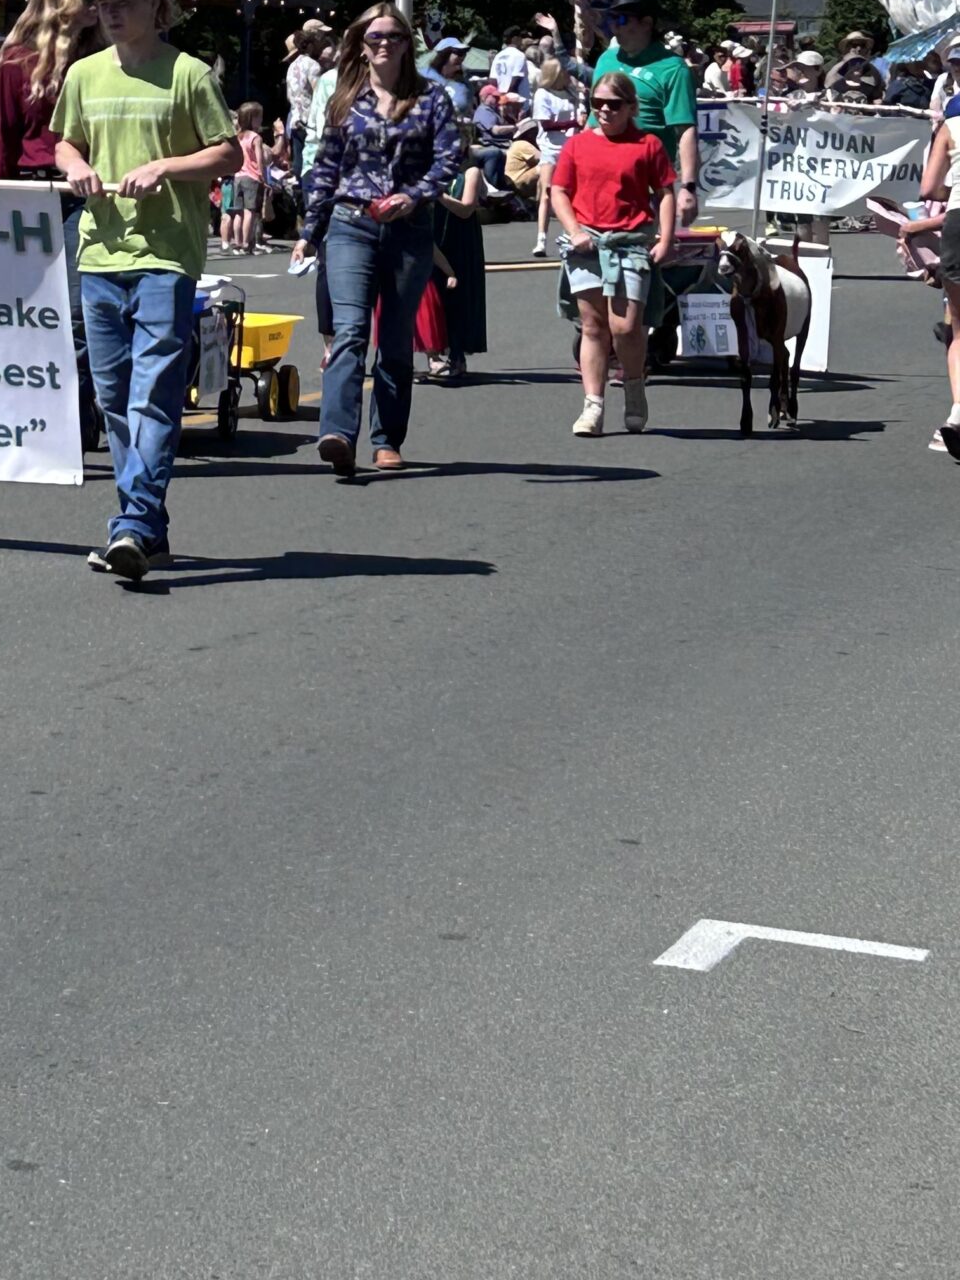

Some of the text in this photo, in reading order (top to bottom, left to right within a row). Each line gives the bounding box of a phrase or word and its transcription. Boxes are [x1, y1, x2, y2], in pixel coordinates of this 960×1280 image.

[768, 126, 875, 154] SAN JUAN
[767, 151, 924, 183] PRESERVATION
[766, 179, 832, 204] TRUST
